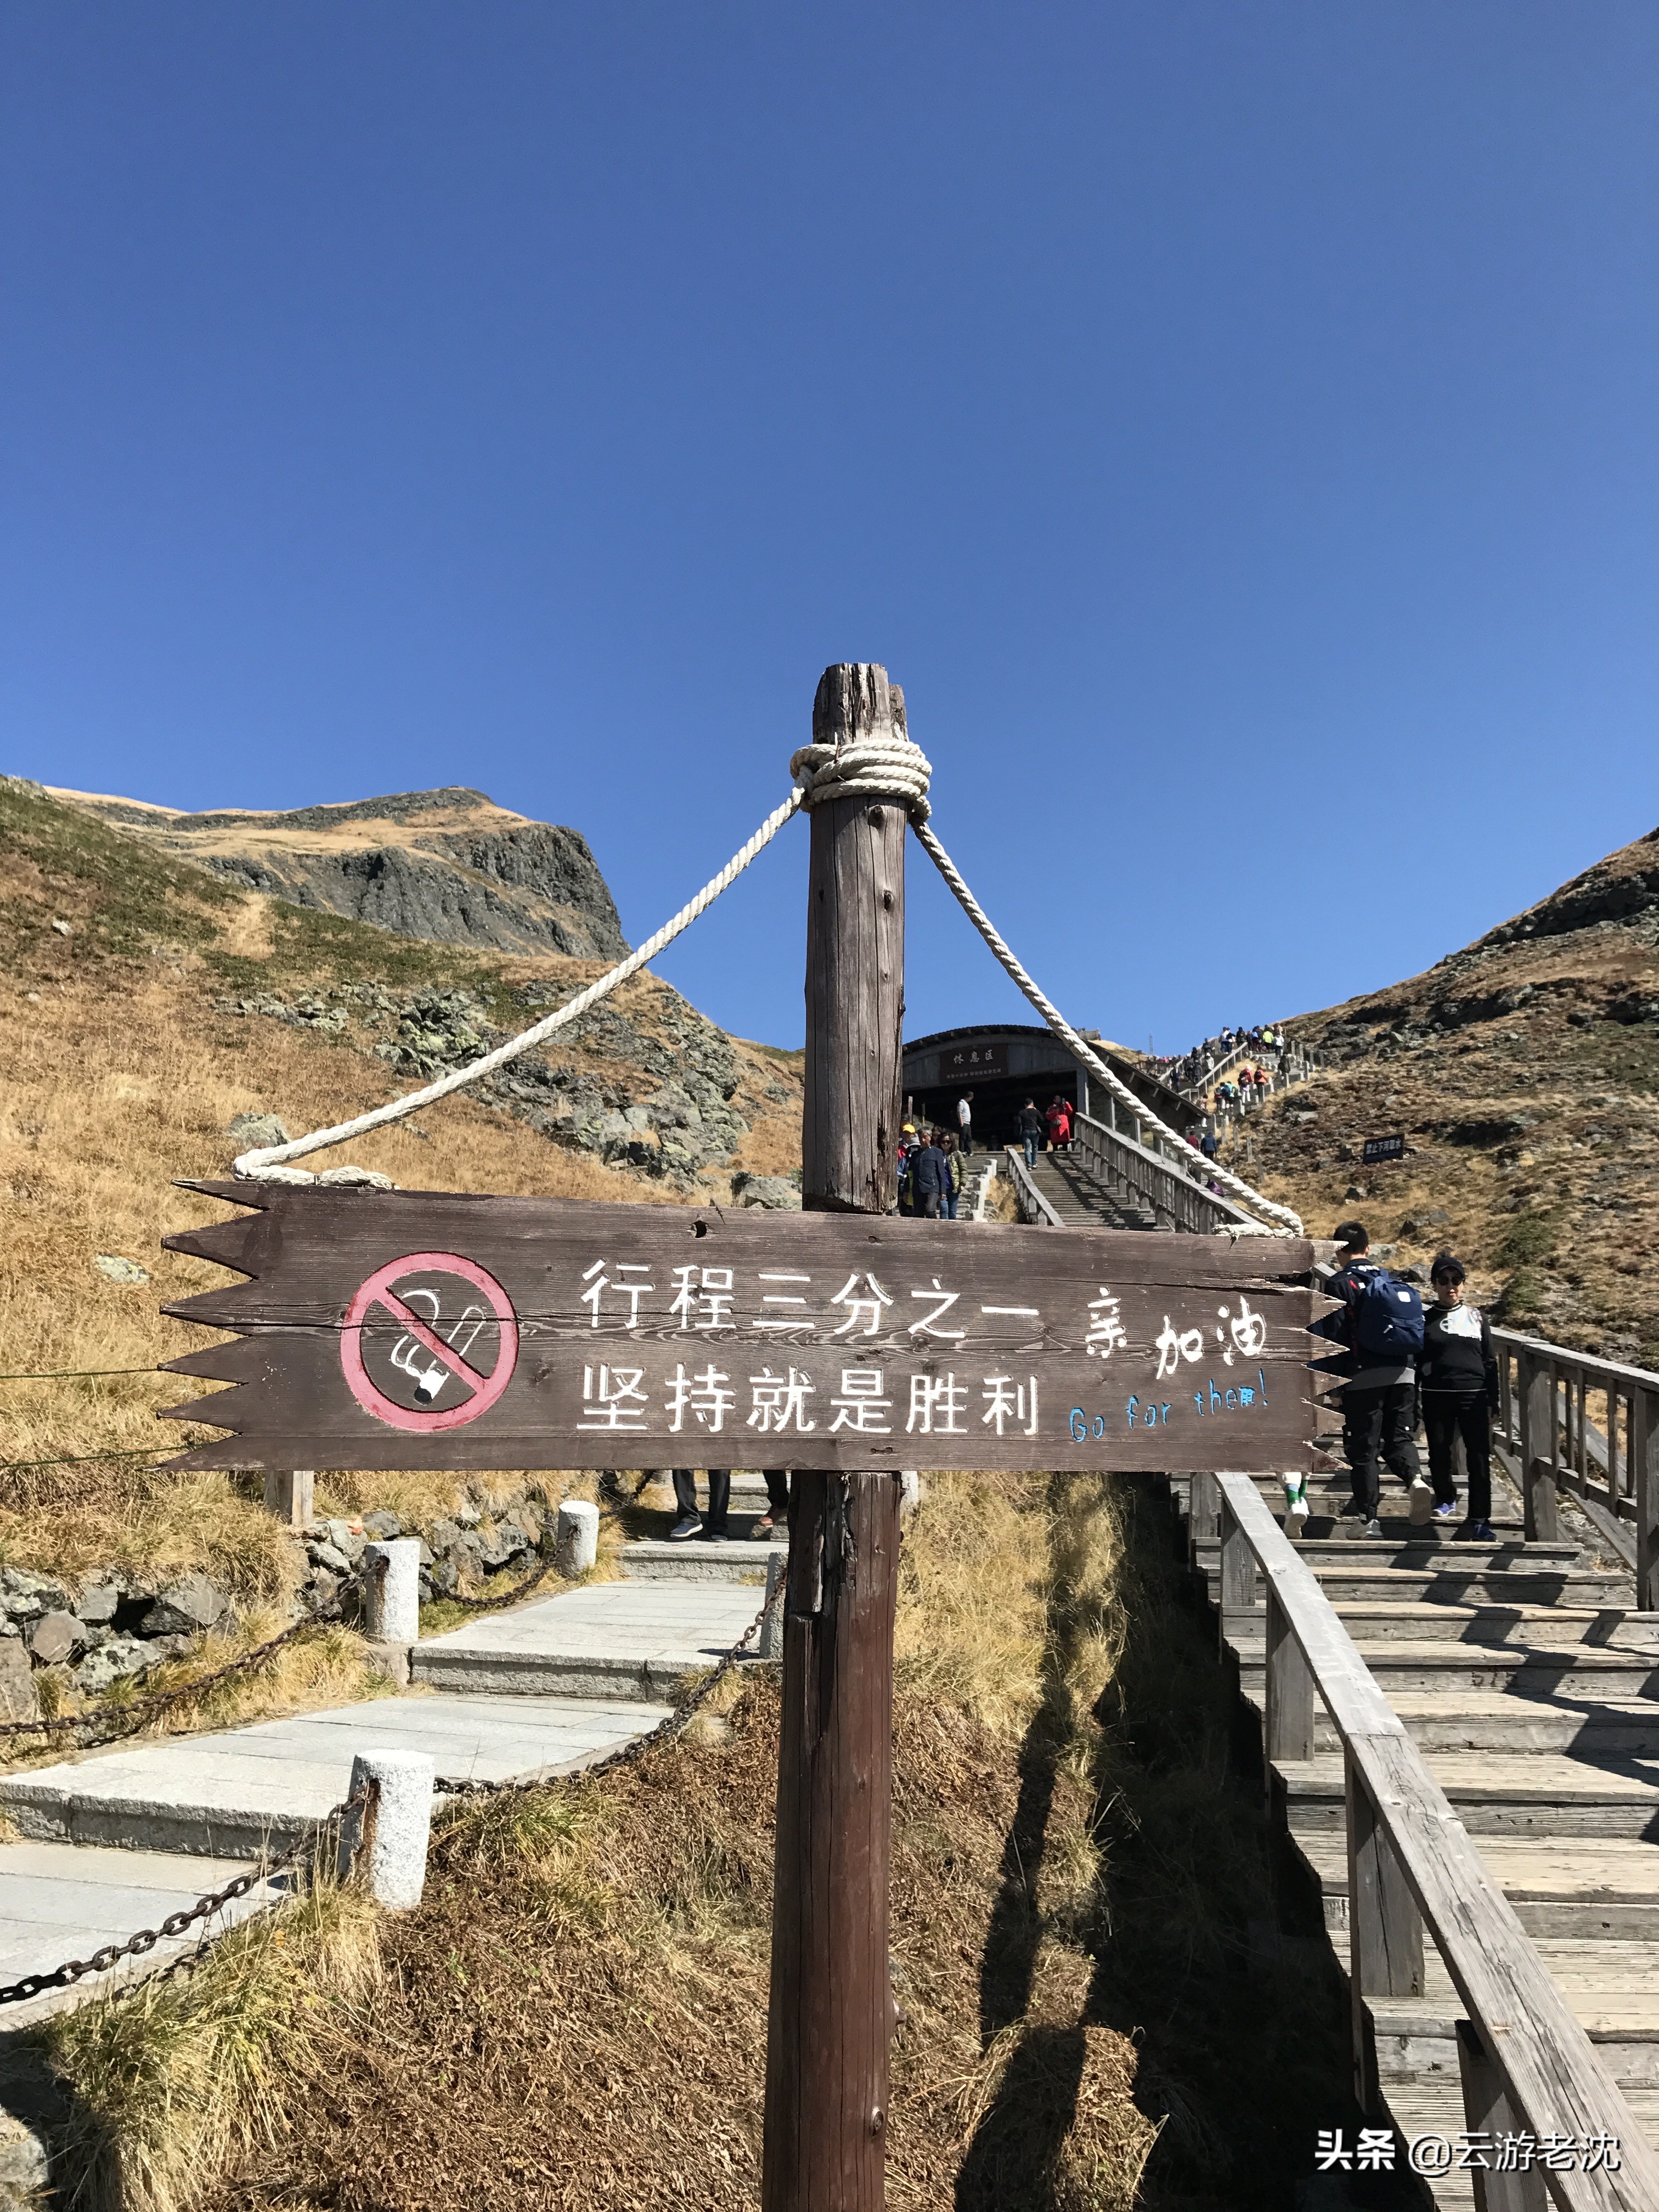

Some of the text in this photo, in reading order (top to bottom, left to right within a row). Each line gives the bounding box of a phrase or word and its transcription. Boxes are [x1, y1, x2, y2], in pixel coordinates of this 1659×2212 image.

[953, 1049, 994, 1064] 休息区
[581, 1258, 1039, 1339] 行程三分之一
[576, 1363, 1039, 1435] 坚持就是胜利
[1069, 1406, 1105, 1442] Go
[1126, 1395, 1172, 1429] for
